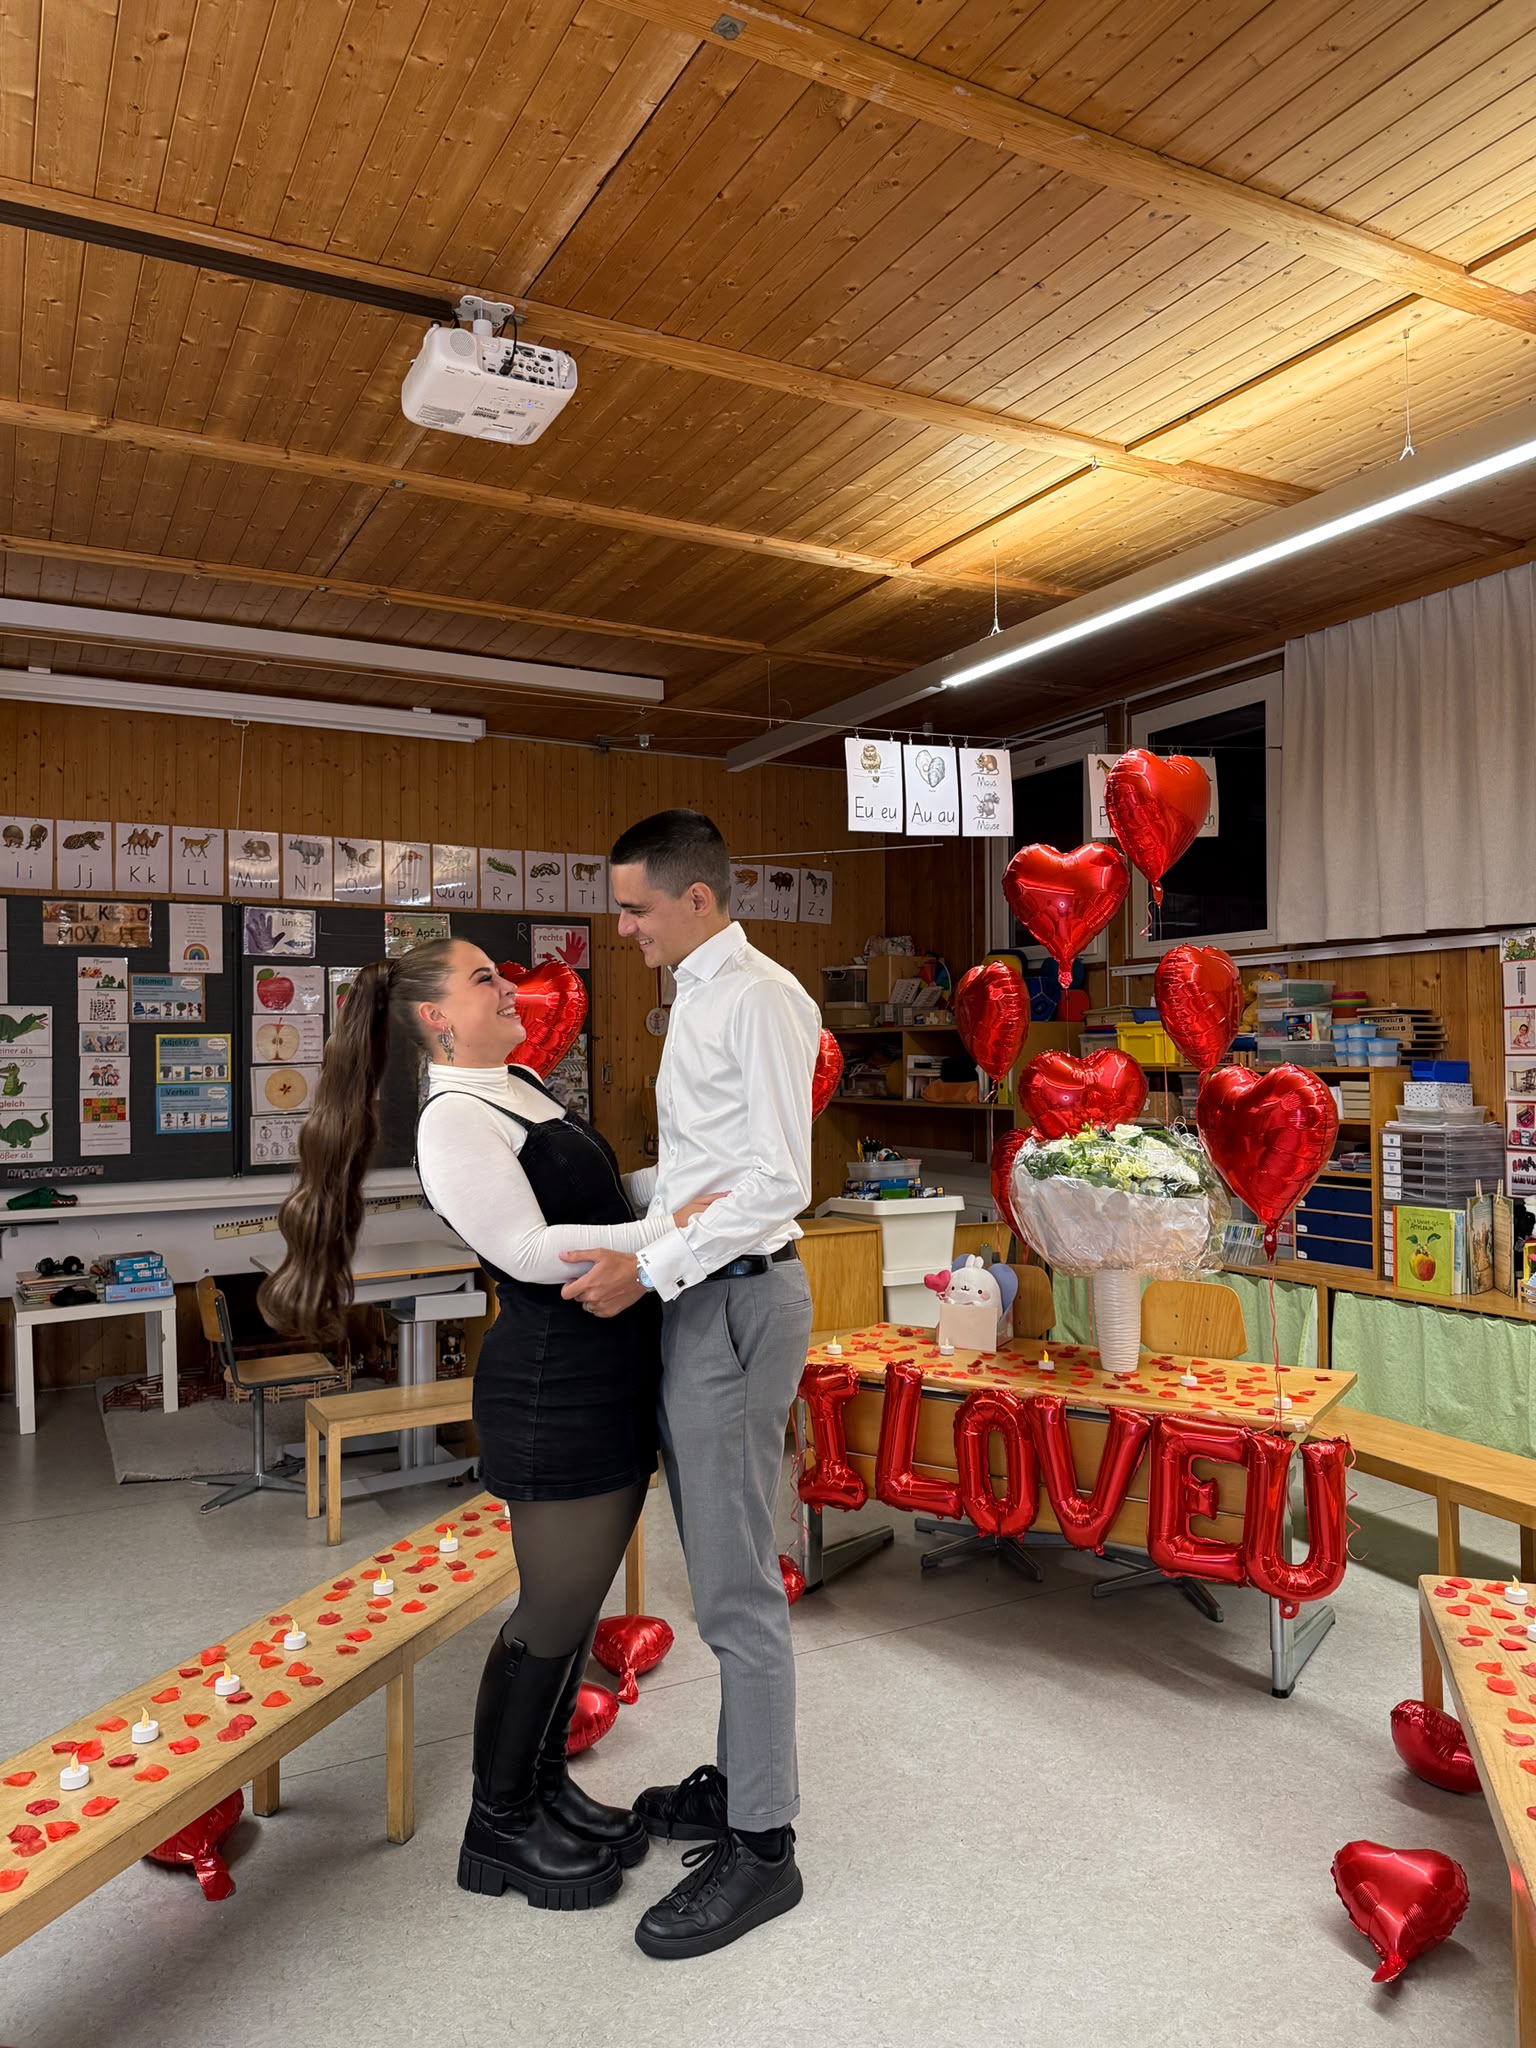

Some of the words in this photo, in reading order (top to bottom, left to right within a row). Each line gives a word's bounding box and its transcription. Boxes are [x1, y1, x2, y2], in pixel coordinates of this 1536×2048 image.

[976, 776, 997, 787] Maus
[855, 796, 874, 819] Eu
[881, 806, 897, 819] eu
[911, 801, 932, 823] Au
[937, 810, 955, 823] au
[282, 917, 304, 928] links
[517, 922, 528, 942] R
[538, 933, 564, 942] rechts
[138, 976, 167, 986] Nomen
[166, 1087, 194, 1096] Verben
[799, 1362, 869, 1512] I
[875, 1359, 1249, 1588] LOVE
[1246, 1432, 1347, 1612] U
